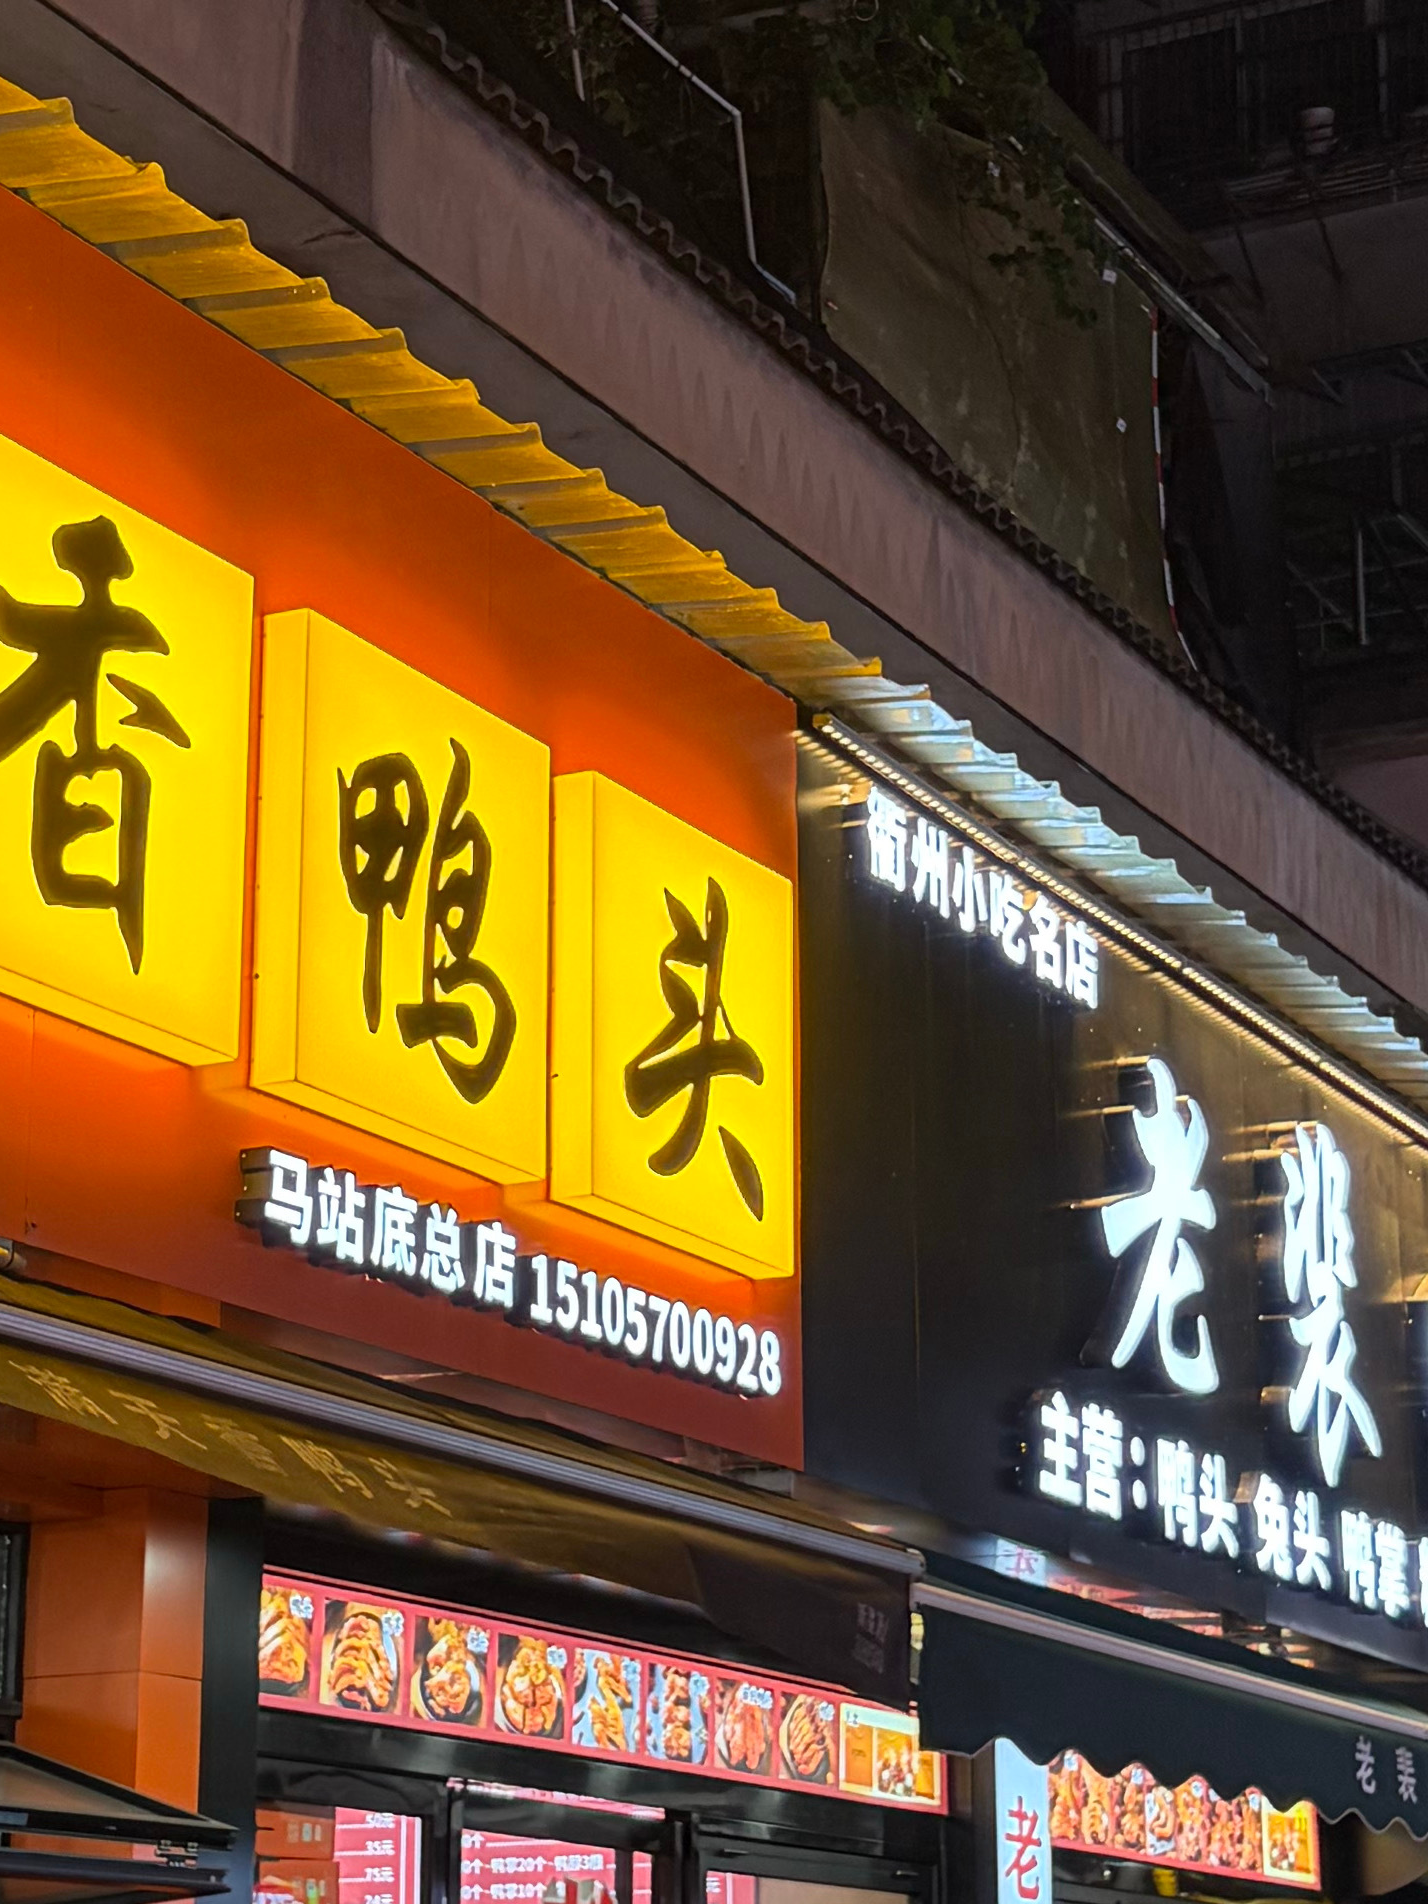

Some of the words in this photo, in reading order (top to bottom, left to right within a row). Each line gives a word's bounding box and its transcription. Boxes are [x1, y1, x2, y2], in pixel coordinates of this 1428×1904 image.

[867, 785, 1100, 1011] 衢州小吃名店
[262, 1150, 517, 1308] 马站底总店
[528, 1251, 782, 1397] 15105700928
[1156, 1435, 1240, 1560] 鸭头
[1253, 1472, 1333, 1591] 兔头
[1340, 1509, 1411, 1619] 鸭掌
